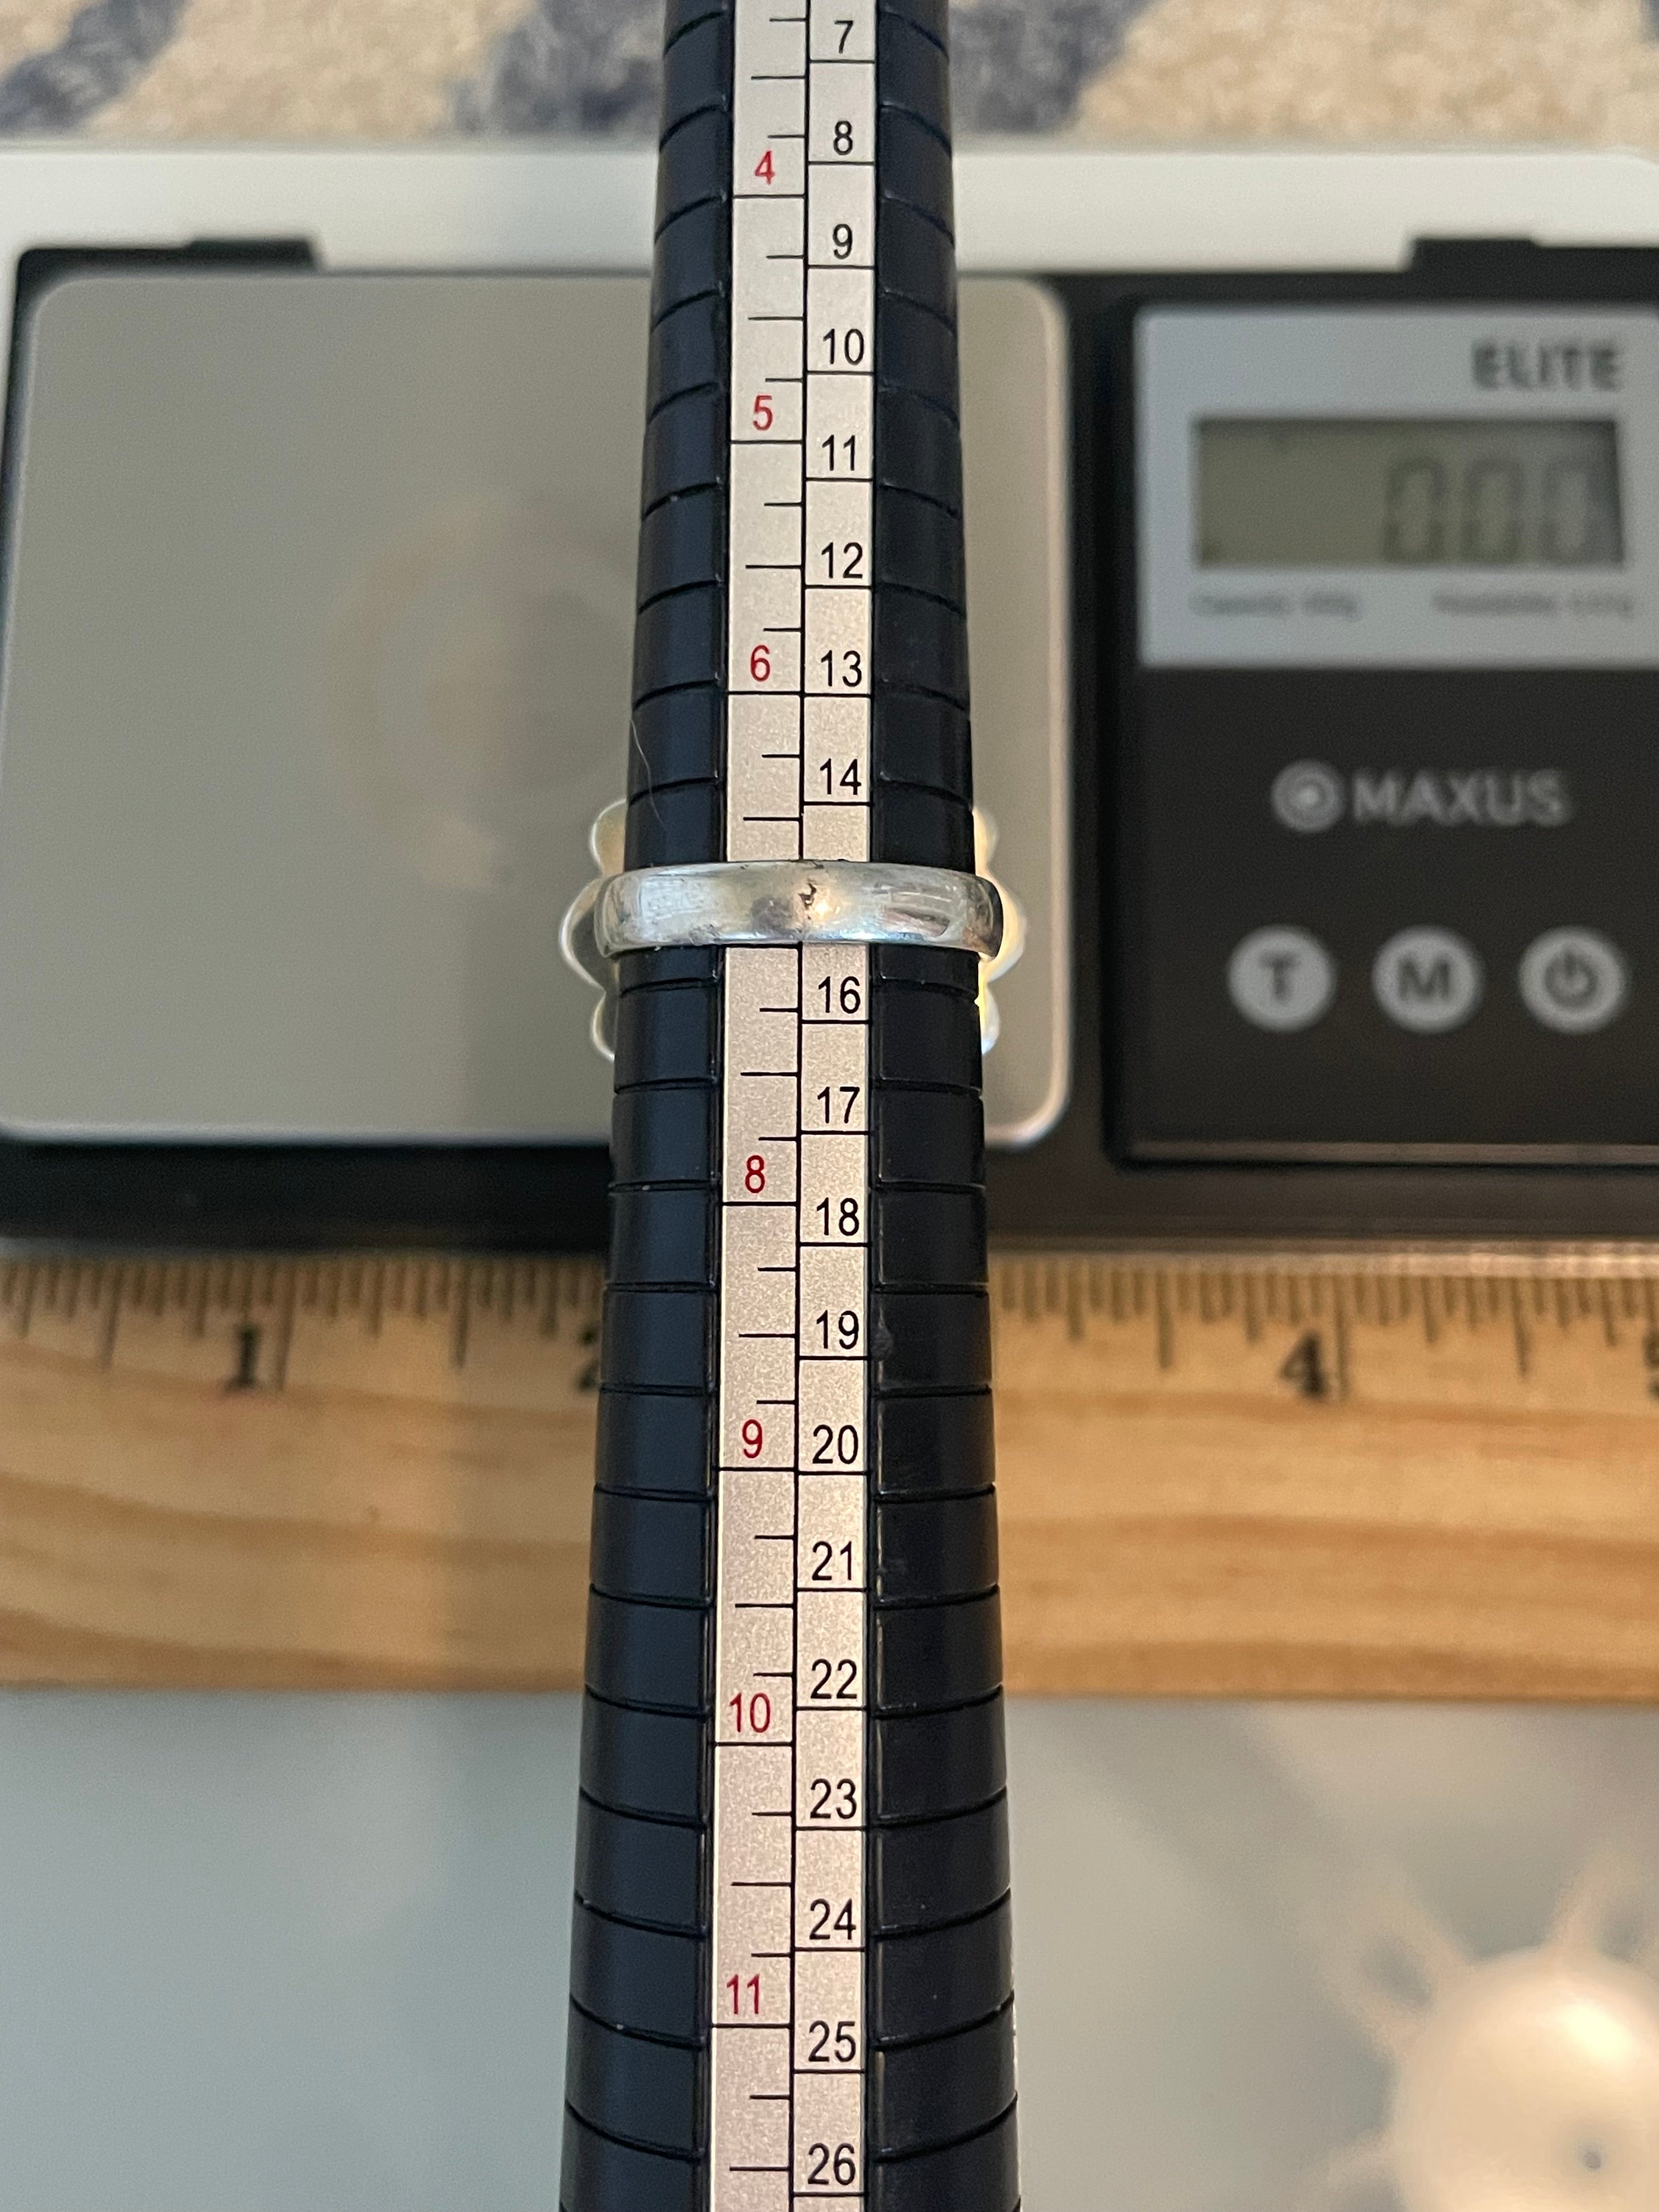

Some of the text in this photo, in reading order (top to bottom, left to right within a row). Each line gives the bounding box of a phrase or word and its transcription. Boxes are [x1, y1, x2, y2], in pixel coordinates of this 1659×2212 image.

[834, 20, 854, 54] 7
[833, 120, 853, 155] 8
[754, 150, 776, 185] 4
[833, 224, 853, 259] 9
[823, 329, 864, 365] 10
[1470, 339, 1621, 391] ELITE
[753, 394, 773, 431] 5
[822, 435, 855, 471] 11
[821, 542, 863, 579] 12
[750, 644, 771, 682] 6
[821, 650, 862, 687] 13
[820, 758, 862, 795] 14
[1352, 769, 1570, 826] MAXUS
[819, 976, 860, 1014] 16
[1258, 950, 1301, 1002] T
[1396, 956, 1452, 1001] M
[817, 1086, 860, 1124] 17
[745, 1155, 766, 1193] 8
[816, 1197, 859, 1236] 18
[816, 1310, 859, 1350] 19
[225, 1322, 263, 1393] 1
[1279, 1328, 1331, 1401] 4
[742, 1419, 763, 1459] 9
[812, 1425, 858, 1464] 20
[812, 1541, 852, 1581] 21
[810, 1658, 857, 1699] 22
[730, 1692, 771, 1733] 10
[810, 1779, 856, 1819] 23
[809, 1899, 856, 1940] 24
[726, 1974, 760, 2015] 11
[808, 2021, 856, 2062] 25
[808, 2143, 855, 2185] 26
